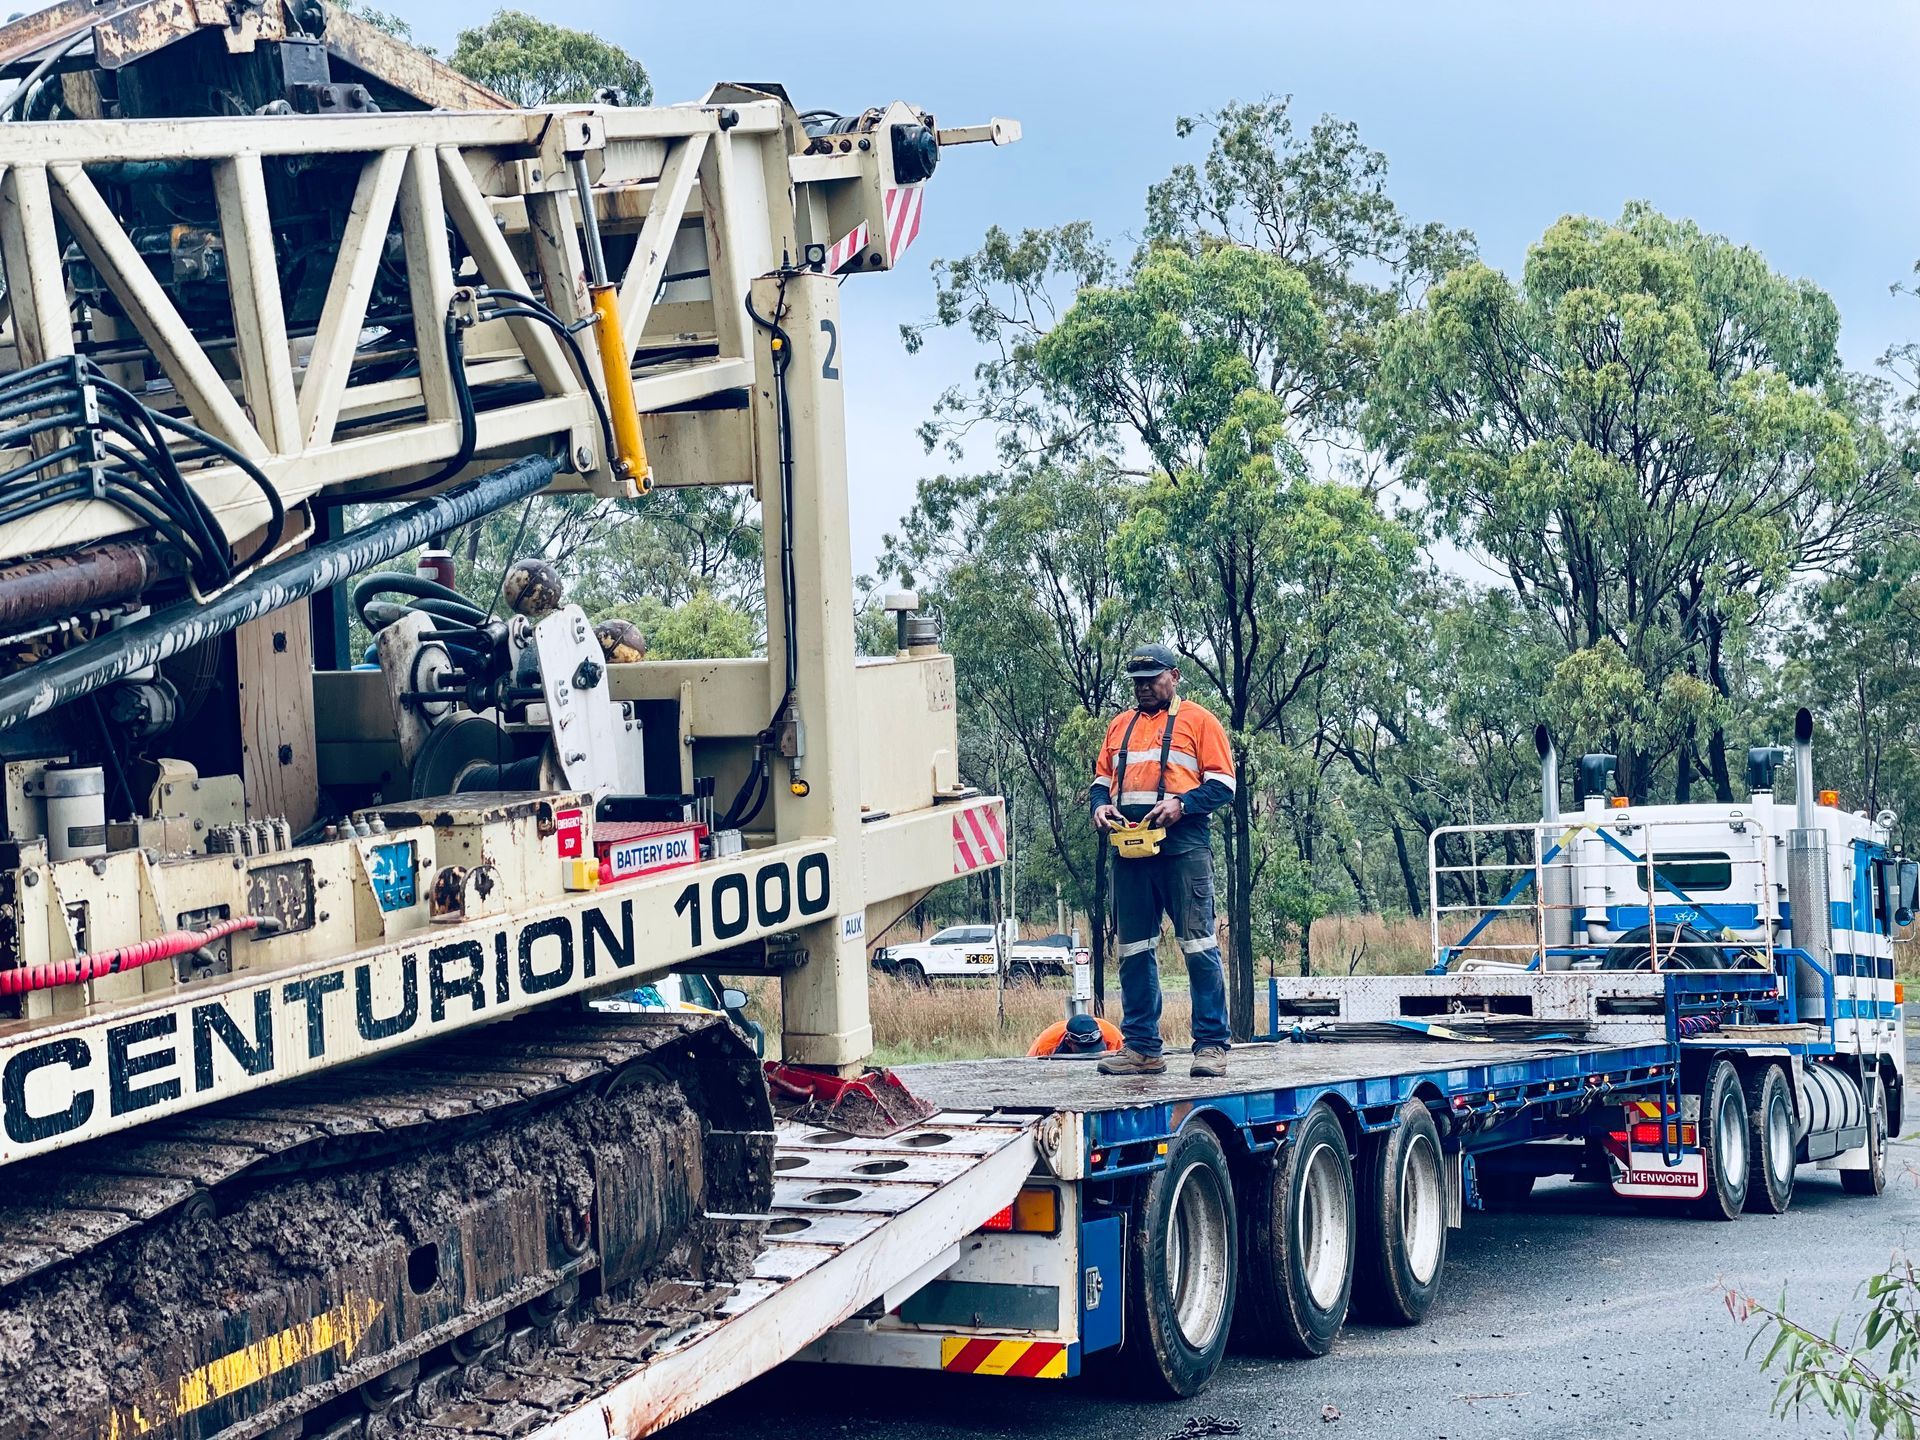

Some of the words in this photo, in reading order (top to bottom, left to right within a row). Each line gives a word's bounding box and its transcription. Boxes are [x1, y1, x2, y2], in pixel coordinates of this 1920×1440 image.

[820, 319, 839, 380] 2
[558, 817, 580, 830] EMERGENCY
[564, 837, 575, 849] STOP
[617, 843, 663, 869] BATTERY
[666, 839, 688, 859] BOX
[845, 915, 862, 936] AUX
[979, 954, 994, 964] 692
[2, 899, 636, 1144] CENTURION
[674, 852, 830, 947] 1000
[1633, 1172, 1696, 1184] KENWORTH
